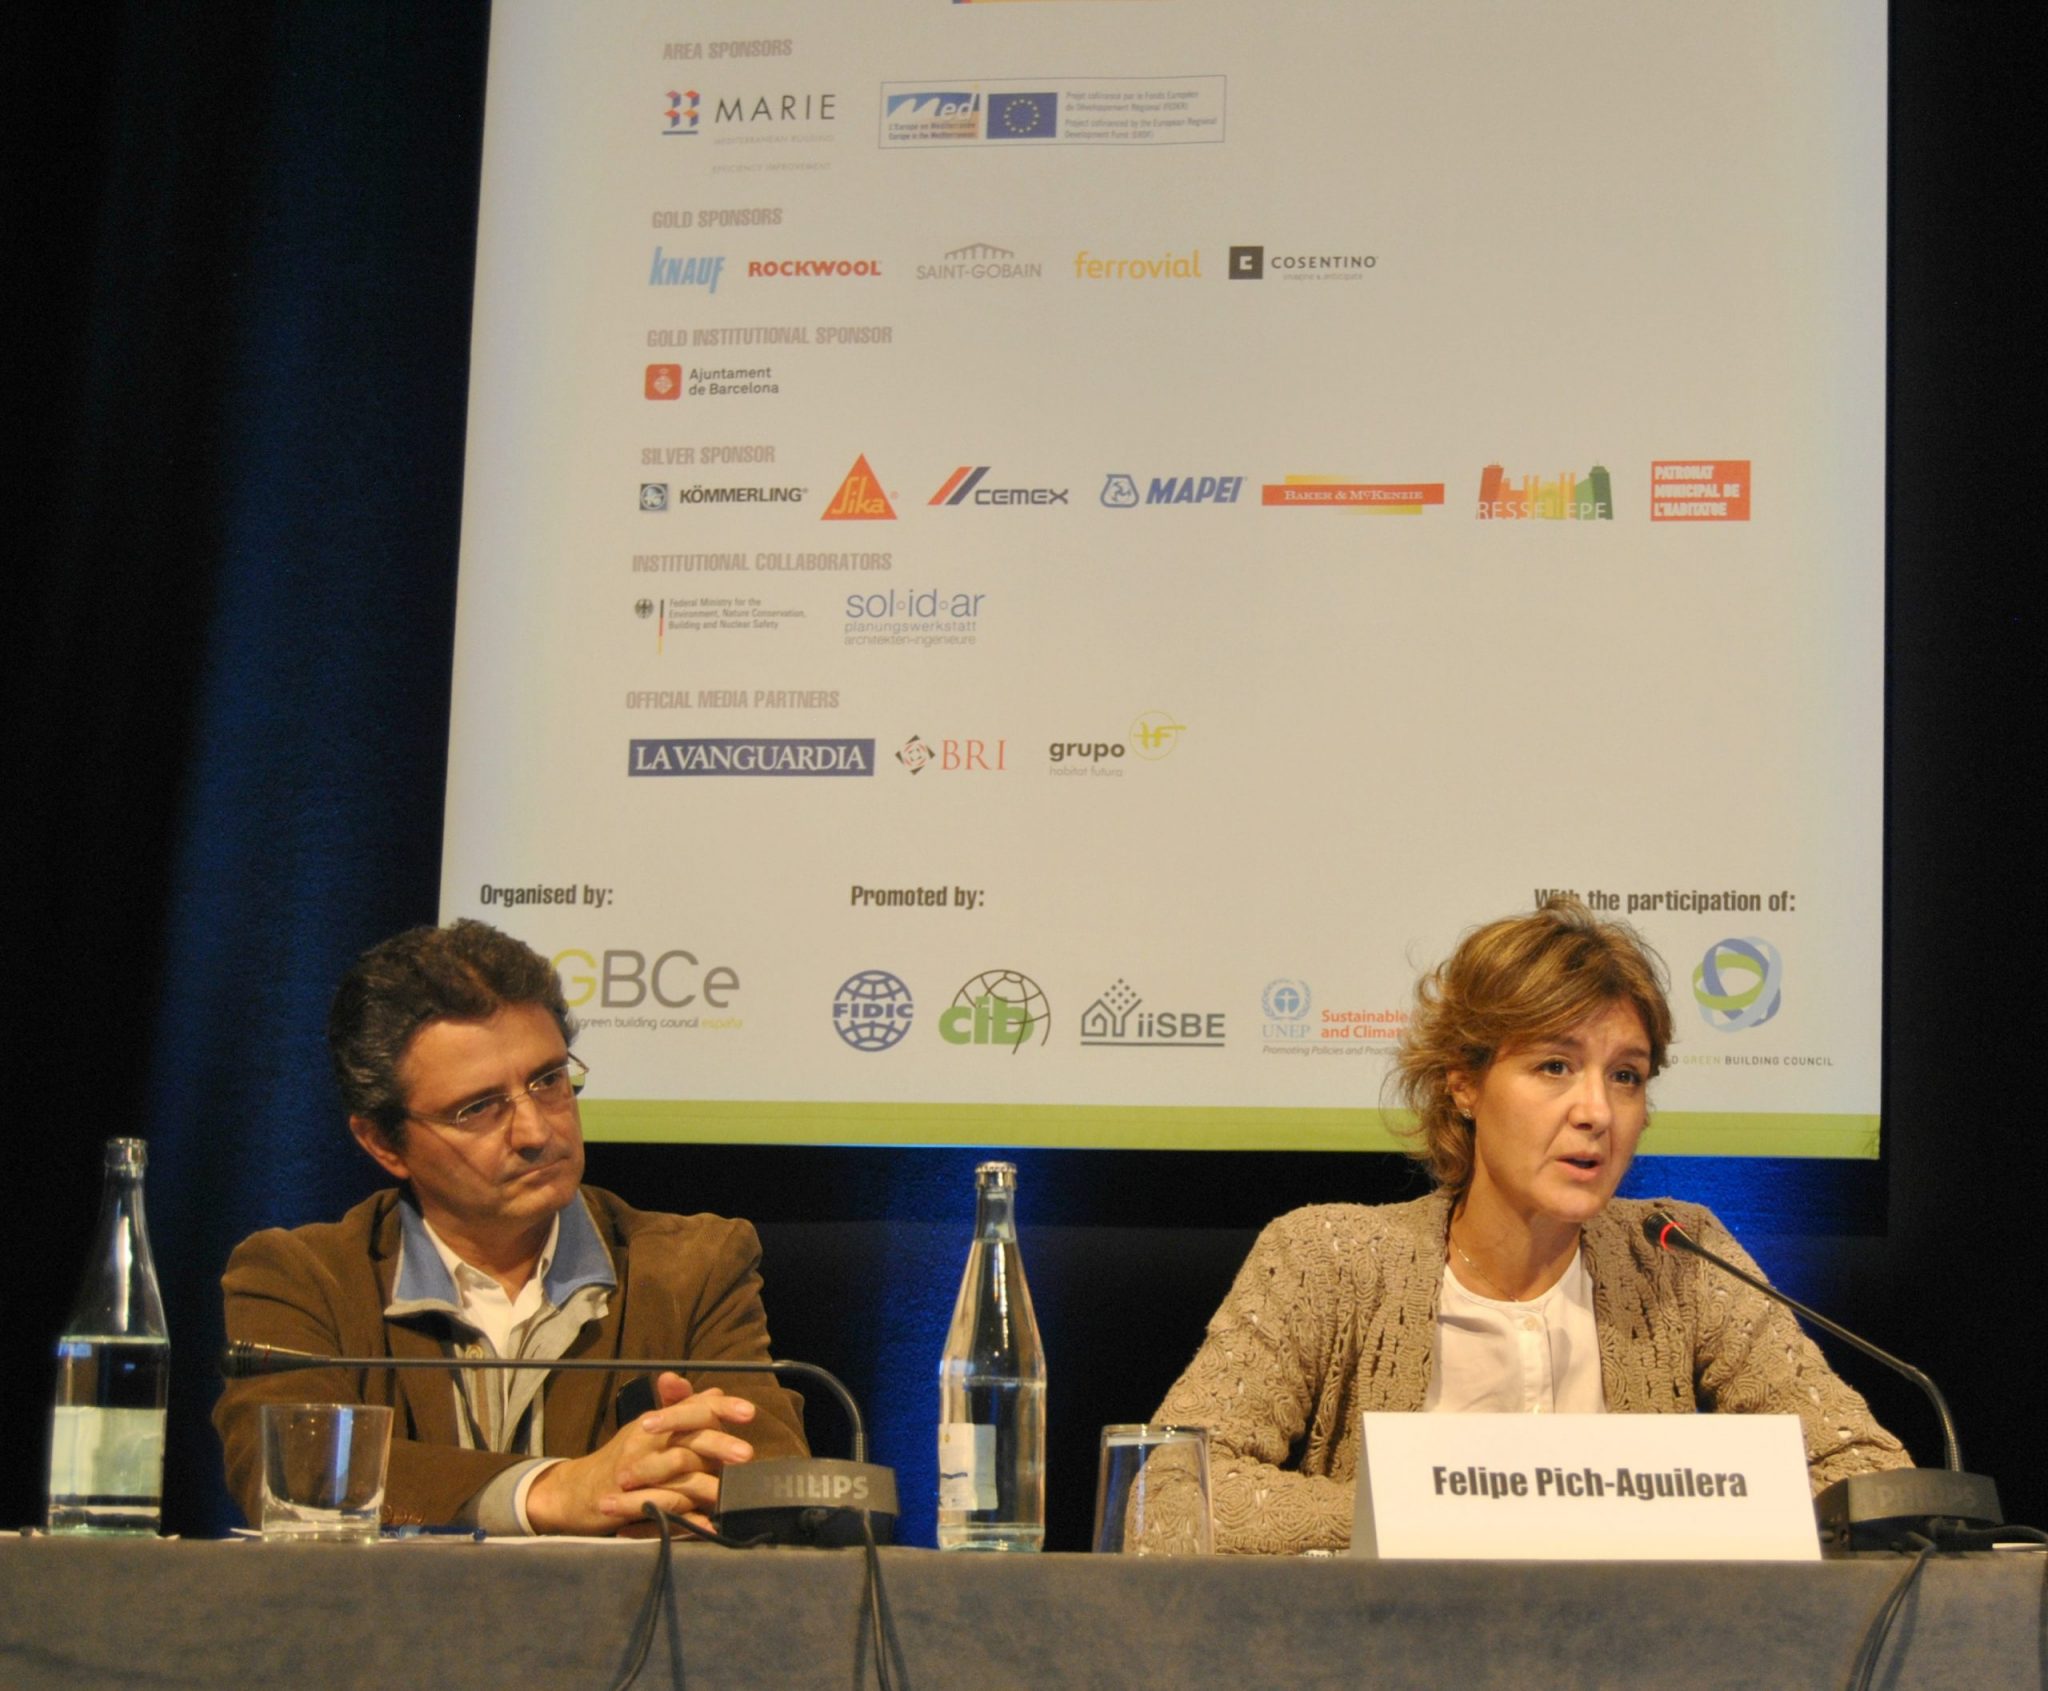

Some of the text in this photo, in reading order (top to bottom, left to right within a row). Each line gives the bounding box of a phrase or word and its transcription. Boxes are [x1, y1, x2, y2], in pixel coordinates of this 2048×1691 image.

[662, 39, 793, 60] AREA SPONSORS
[715, 94, 836, 123] MARIE
[888, 93, 977, 120] Med
[652, 208, 783, 228] GOLD SPONSORS
[748, 260, 881, 278] ROCKWOOL
[916, 263, 1042, 280] SAINT-GOBAIN
[1074, 250, 1202, 279] ferrovial
[1271, 255, 1377, 269] COSENTINO
[647, 325, 892, 347] GOLD INSTITUTIONAL SPONSOR
[690, 367, 771, 384] Ajuntament
[689, 381, 779, 396] de Barcelona
[641, 446, 775, 465] SILVER SPONSOR
[831, 476, 885, 515] Sika
[975, 489, 1069, 505] CEMEX
[1146, 476, 1243, 504] MAPEI
[1285, 490, 1333, 500] BAKER
[1335, 491, 1346, 500] &
[632, 553, 892, 572] INSTITUTIONAL COLLABORATORS
[669, 597, 762, 608] Federal Ministry for the
[723, 609, 749, 617] Nature
[669, 619, 778, 631] Building and Nuclear Safety
[626, 690, 840, 709] OFFICIAL MEDIA PARTNERS
[941, 739, 1007, 770] BRI
[1049, 741, 1125, 763] grupo
[1049, 765, 1087, 777] habitat
[481, 884, 614, 908] Organised by:
[851, 885, 985, 910] Promoted by:
[1587, 890, 1620, 911] the
[1627, 889, 1761, 914] participation
[1768, 890, 1796, 912] of:
[552, 948, 740, 1008] GBCe
[833, 1003, 914, 1019] FIDIC
[938, 996, 1035, 1045] cib
[1321, 1010, 1408, 1023] Sustainable
[614, 1016, 657, 1030] building
[660, 1016, 698, 1028] council
[1138, 1012, 1225, 1038] iiSBE
[1262, 1024, 1311, 1038] UNEP
[1321, 1025, 1402, 1038] and Climat
[1725, 1056, 1779, 1065] BUILDING
[1783, 1056, 1834, 1066] COUNCIL
[766, 1475, 869, 1500] HILIPS
[1432, 1466, 1748, 1501] Felipe Pich-Aguilera
